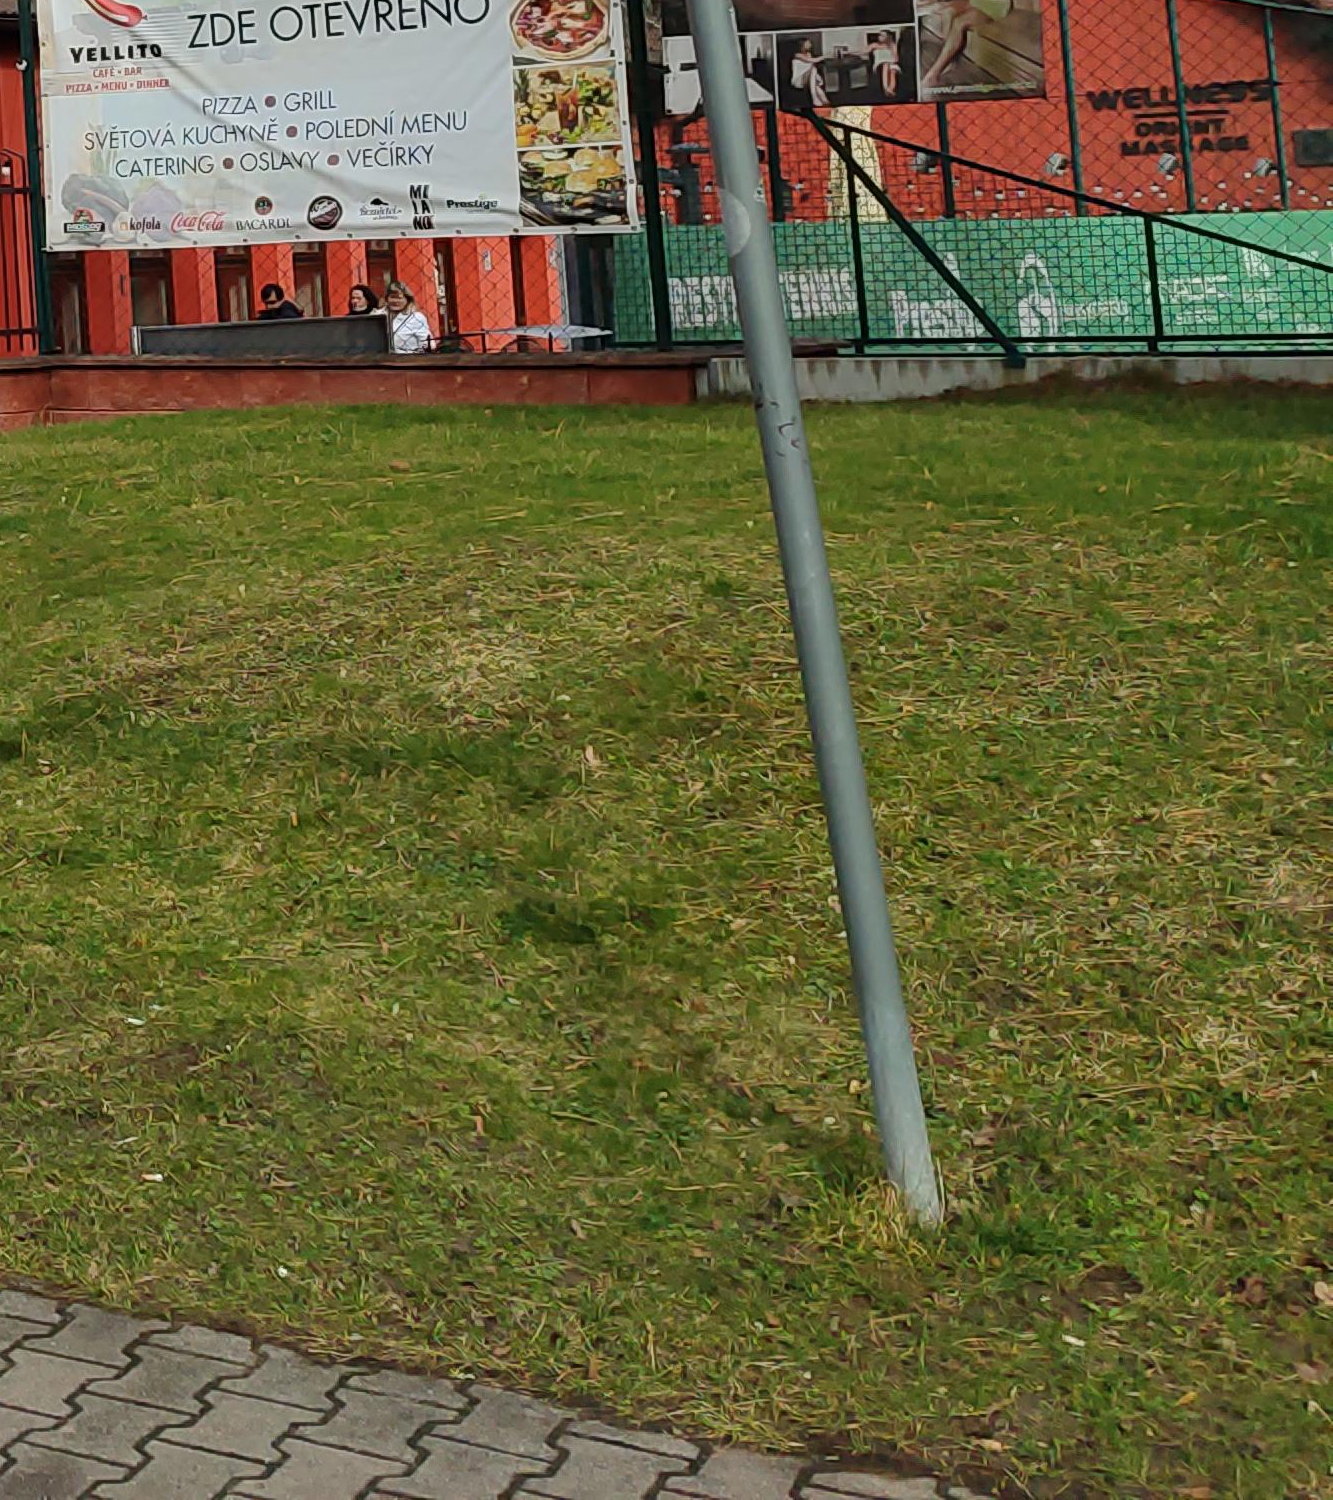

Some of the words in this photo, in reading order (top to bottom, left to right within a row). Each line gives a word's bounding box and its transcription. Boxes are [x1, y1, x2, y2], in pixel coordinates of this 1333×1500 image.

[187, 9, 257, 49] ZDE
[69, 43, 163, 64] YELLITO
[124, 66, 142, 76] BAR
[65, 83, 93, 93] PIZZA
[100, 81, 128, 92] MENU
[136, 78, 171, 90] DINNER
[201, 96, 258, 116] PIZZA
[283, 90, 337, 113] GRILL
[84, 122, 176, 152] SVĚTOVÁ
[182, 118, 279, 146] KUCHYNĚ
[305, 109, 395, 141] POLEDNÍ
[401, 111, 468, 134] MENU
[1120, 135, 1249, 156] MASAGE
[115, 154, 215, 178] CATERING
[239, 150, 321, 173] OSLAVY
[346, 141, 435, 169] VEČÍRKY
[129, 214, 161, 233] kofola
[235, 218, 293, 231] BACARDI
